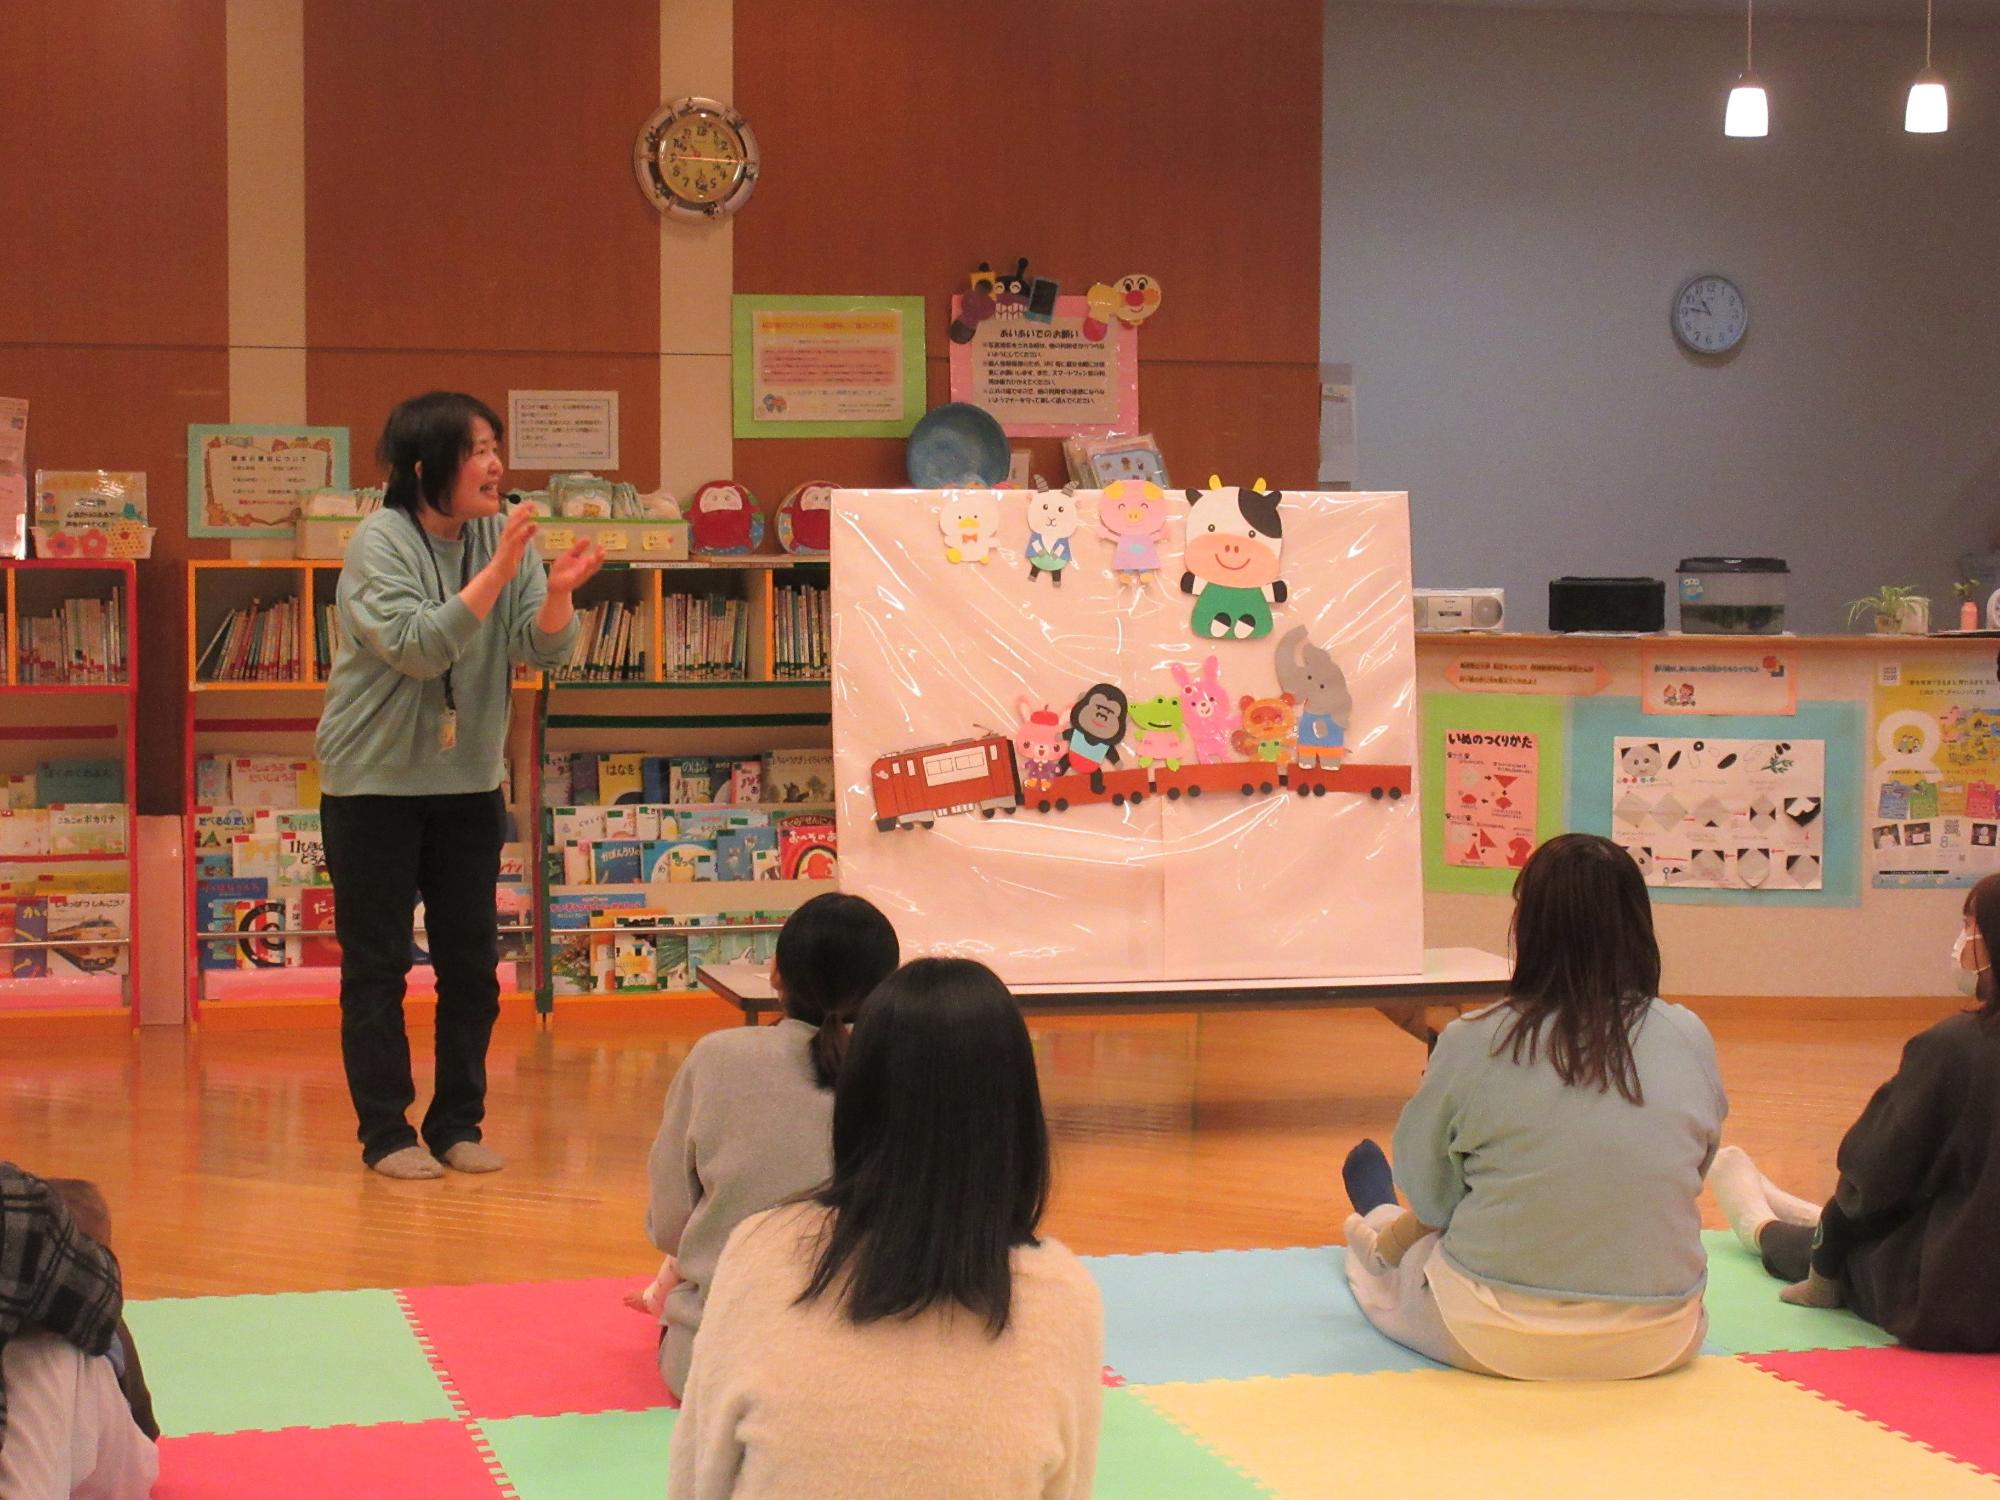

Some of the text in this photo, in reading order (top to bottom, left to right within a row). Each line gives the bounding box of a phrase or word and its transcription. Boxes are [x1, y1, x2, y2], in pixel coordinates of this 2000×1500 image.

[672, 166, 680, 177] 8
[682, 177, 689, 187] 7
[1000, 329, 1079, 339] あいあいでのお願い
[1447, 733, 1534, 749] いぬのつくりかた
